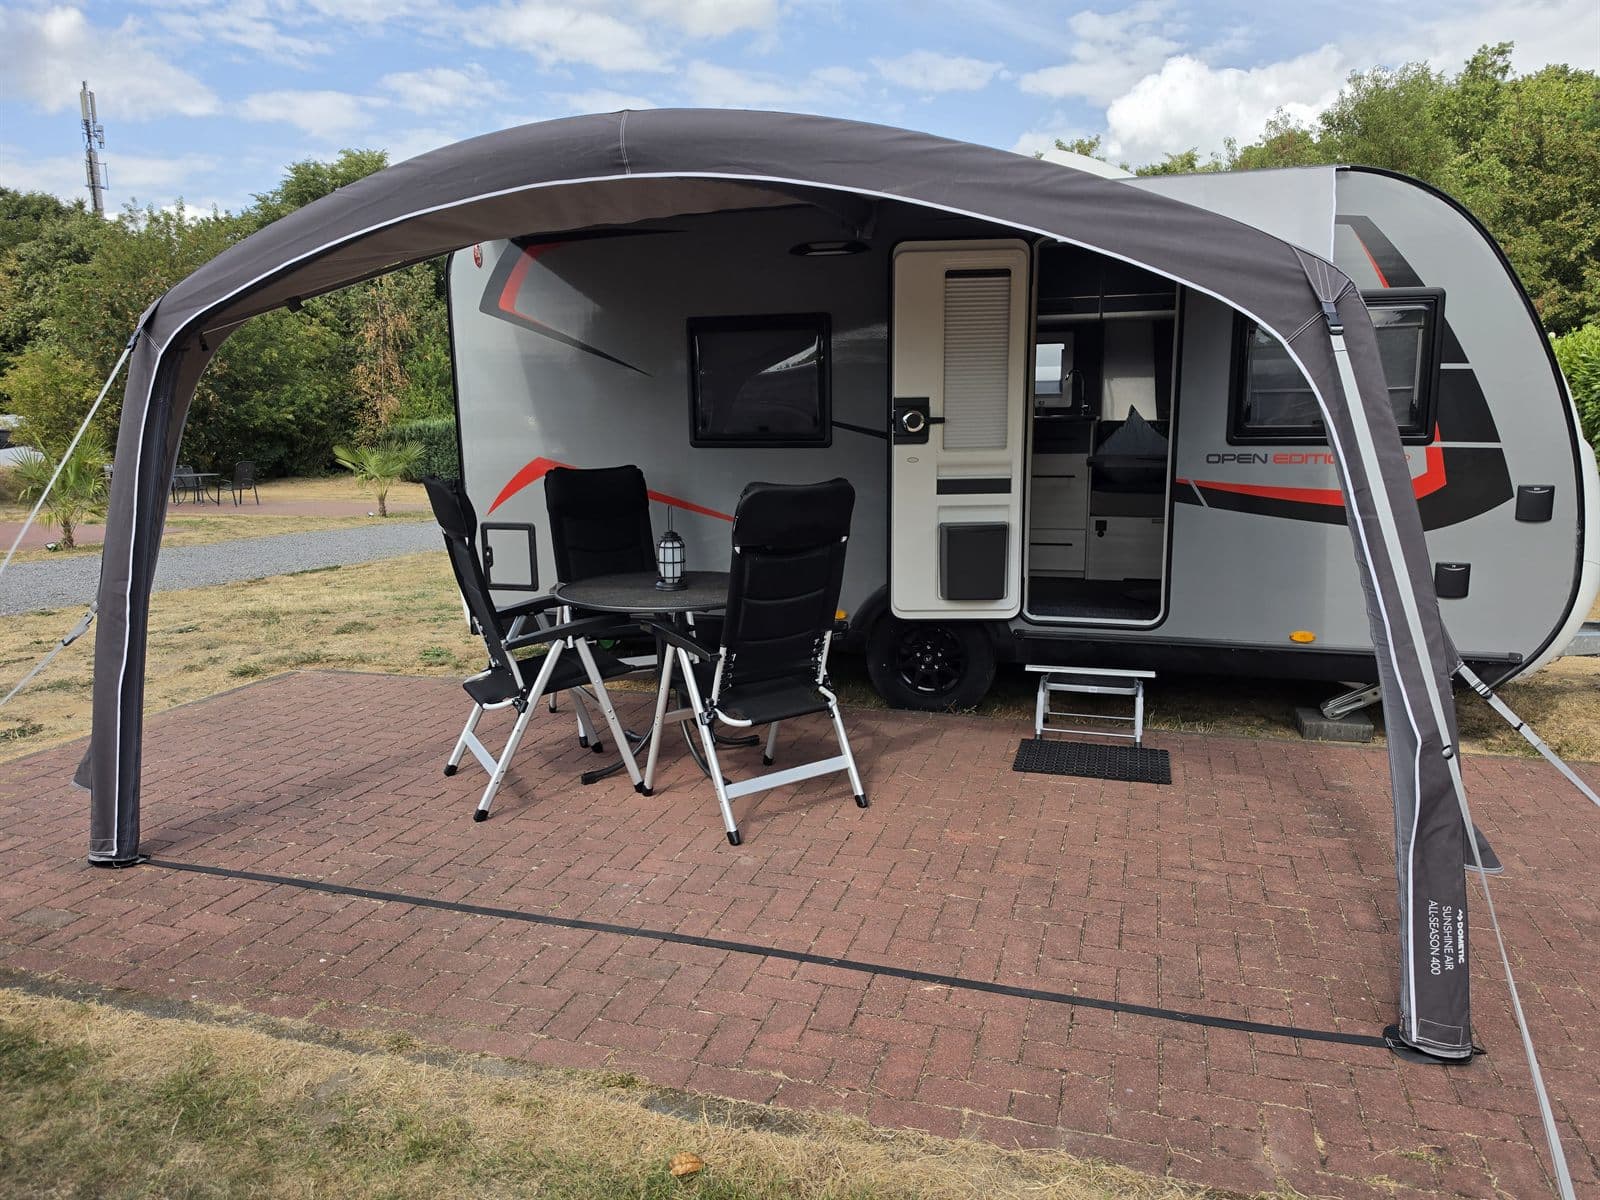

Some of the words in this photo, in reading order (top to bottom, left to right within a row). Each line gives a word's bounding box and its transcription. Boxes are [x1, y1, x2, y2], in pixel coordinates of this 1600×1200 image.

[1206, 453, 1268, 464] OPEN
[1428, 899, 1440, 956] ALL-SEASON
[1442, 905, 1454, 954] SUNSHINE
[1457, 922, 1465, 964] DOMETIC
[1430, 957, 1441, 976] 400
[1444, 955, 1454, 970] AIR
